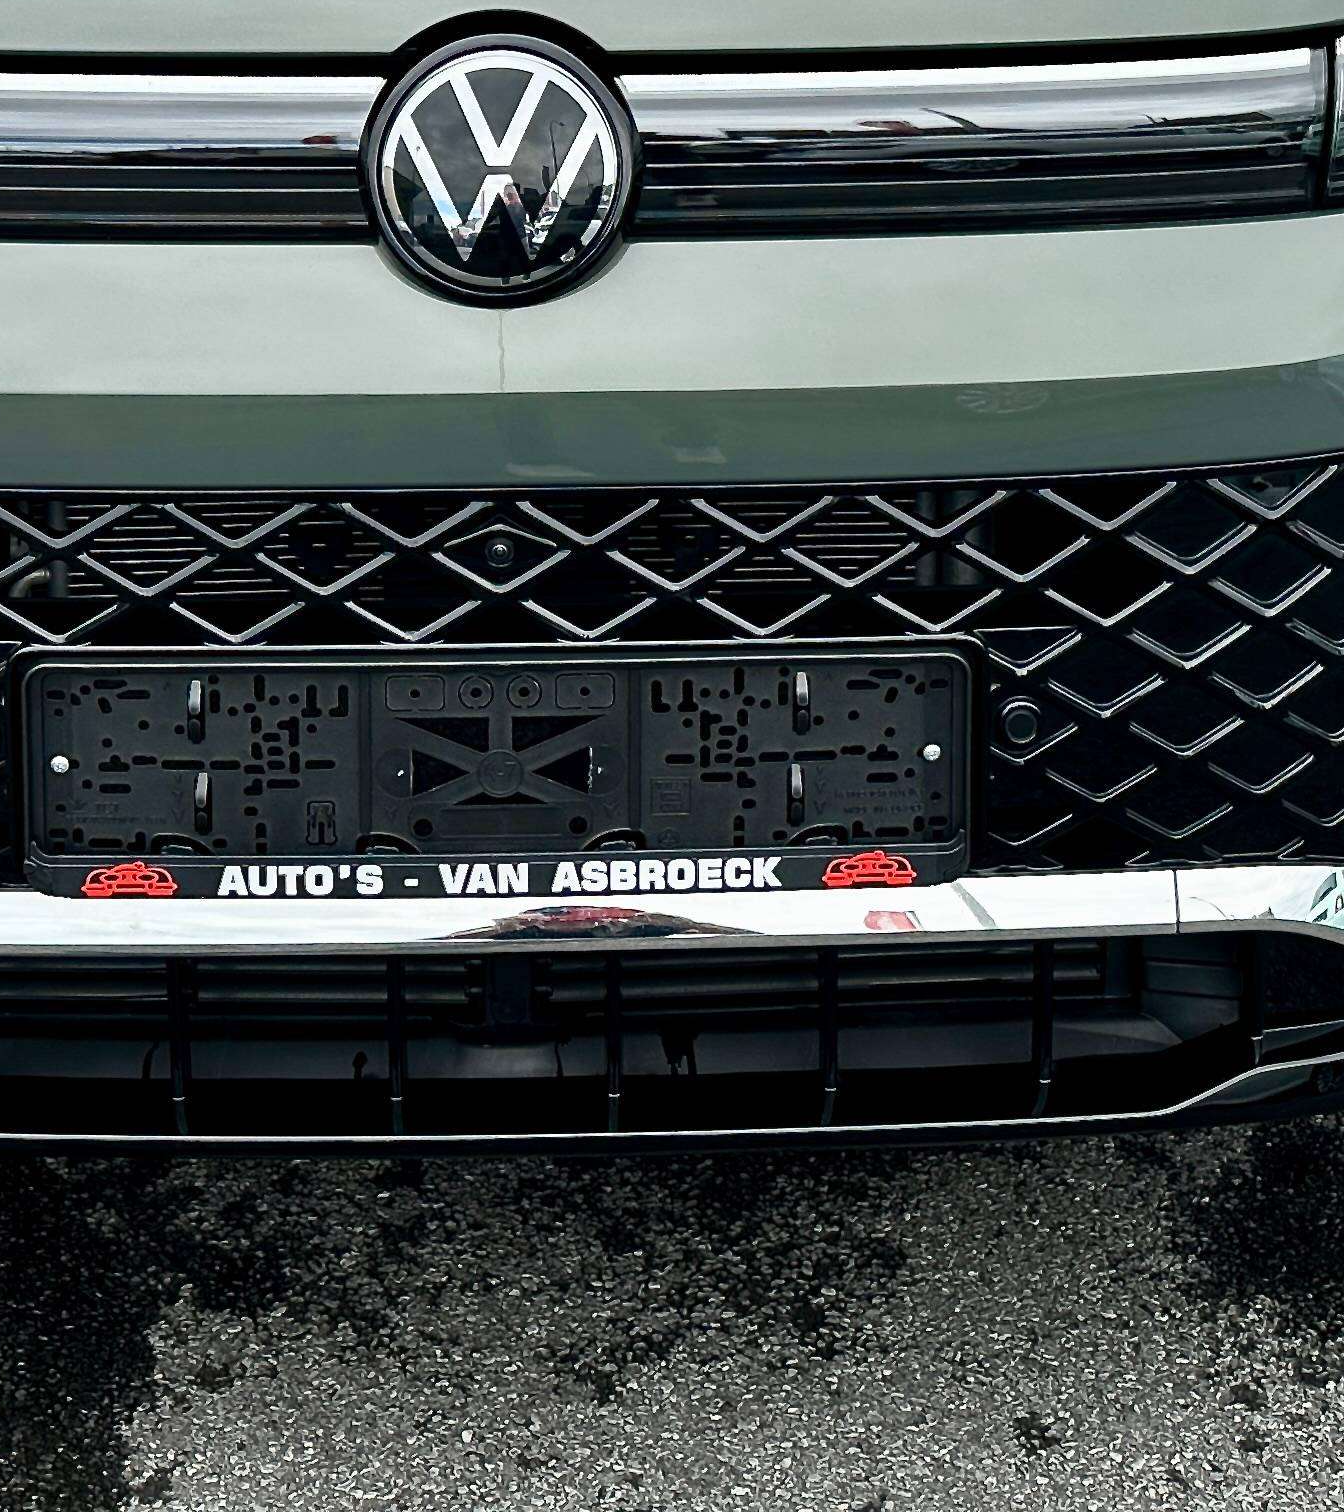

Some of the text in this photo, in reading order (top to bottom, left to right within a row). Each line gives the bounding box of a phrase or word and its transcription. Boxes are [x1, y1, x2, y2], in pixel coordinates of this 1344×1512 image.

[217, 856, 783, 897] AUTO'S - VAN ASBROECK
